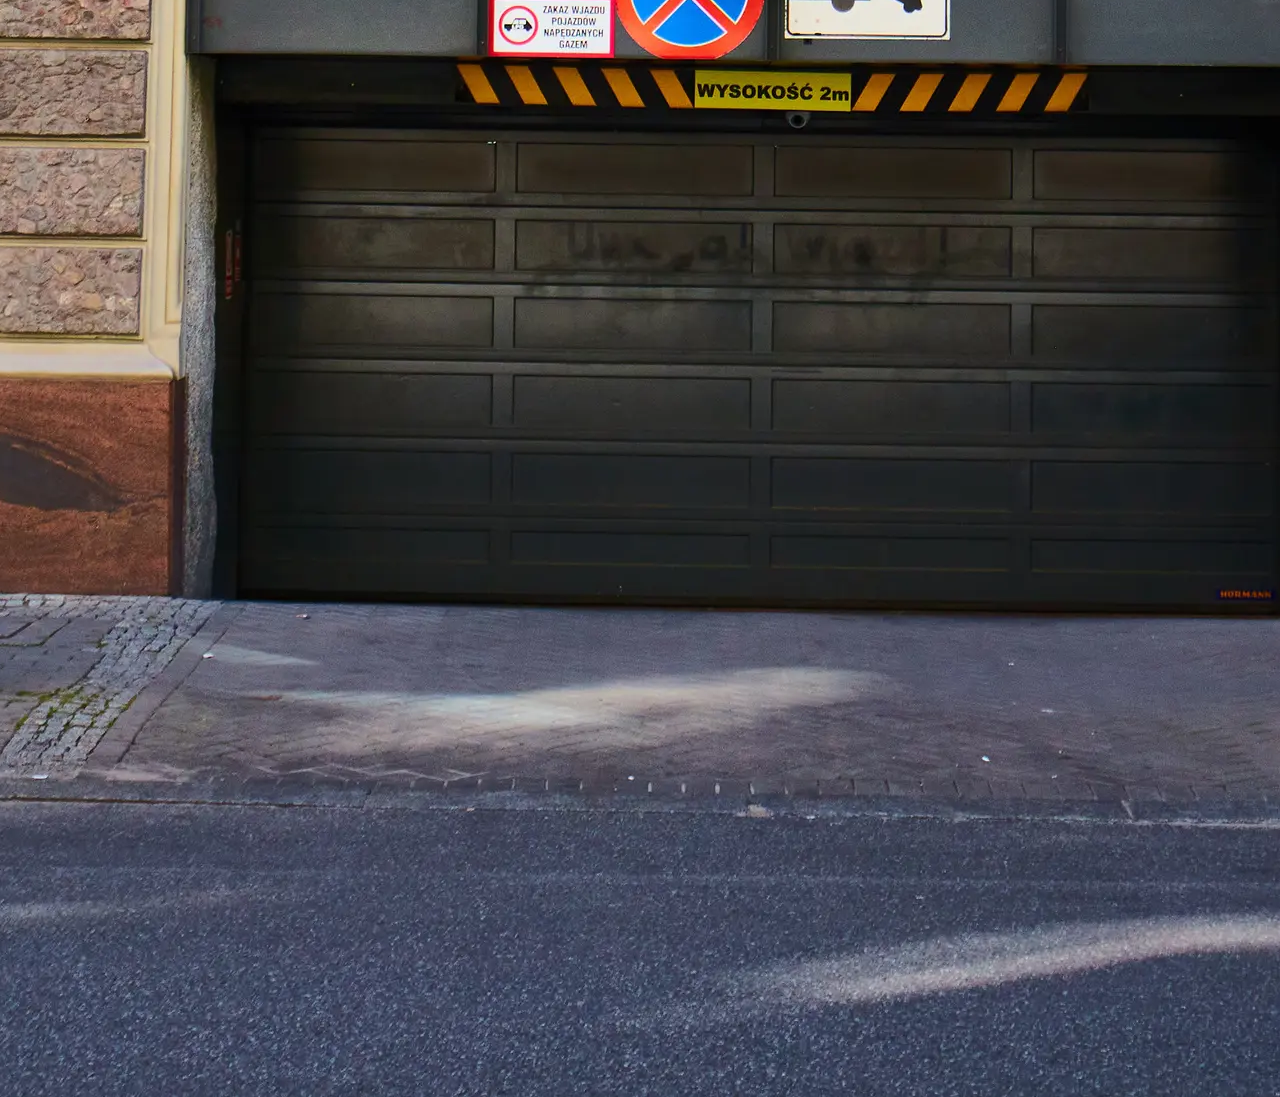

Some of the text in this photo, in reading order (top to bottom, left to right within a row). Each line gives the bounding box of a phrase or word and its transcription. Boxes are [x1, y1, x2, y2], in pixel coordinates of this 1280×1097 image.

[543, 5, 606, 15] ZAKAZ WJAZDU
[551, 15, 597, 26] POJAZDÓW
[543, 28, 604, 39] NAPĘDZANYCH
[559, 40, 588, 49] GAZEM
[697, 82, 850, 102] WYSOKOŚĆ 2m
